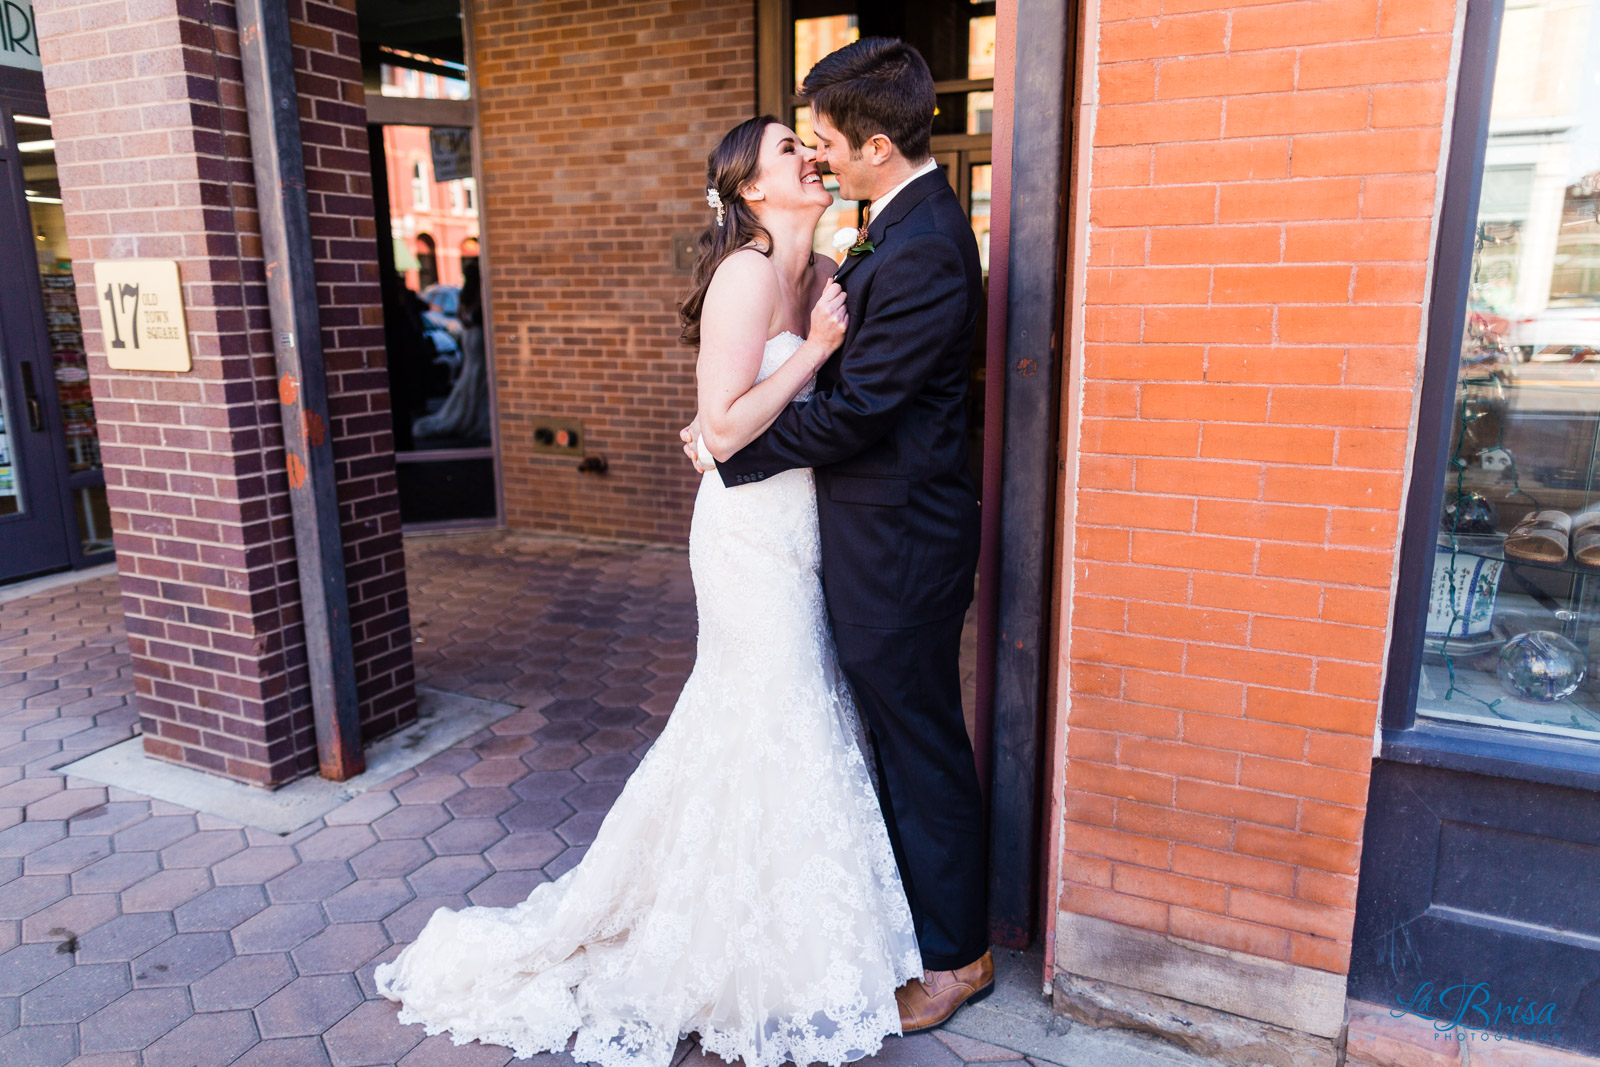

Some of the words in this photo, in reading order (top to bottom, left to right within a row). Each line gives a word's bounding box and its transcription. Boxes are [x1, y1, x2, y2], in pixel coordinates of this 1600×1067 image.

[142, 293, 159, 306] OLD
[104, 282, 140, 349] 17
[144, 310, 169, 323] TOWN
[146, 326, 180, 340] SQUARE
